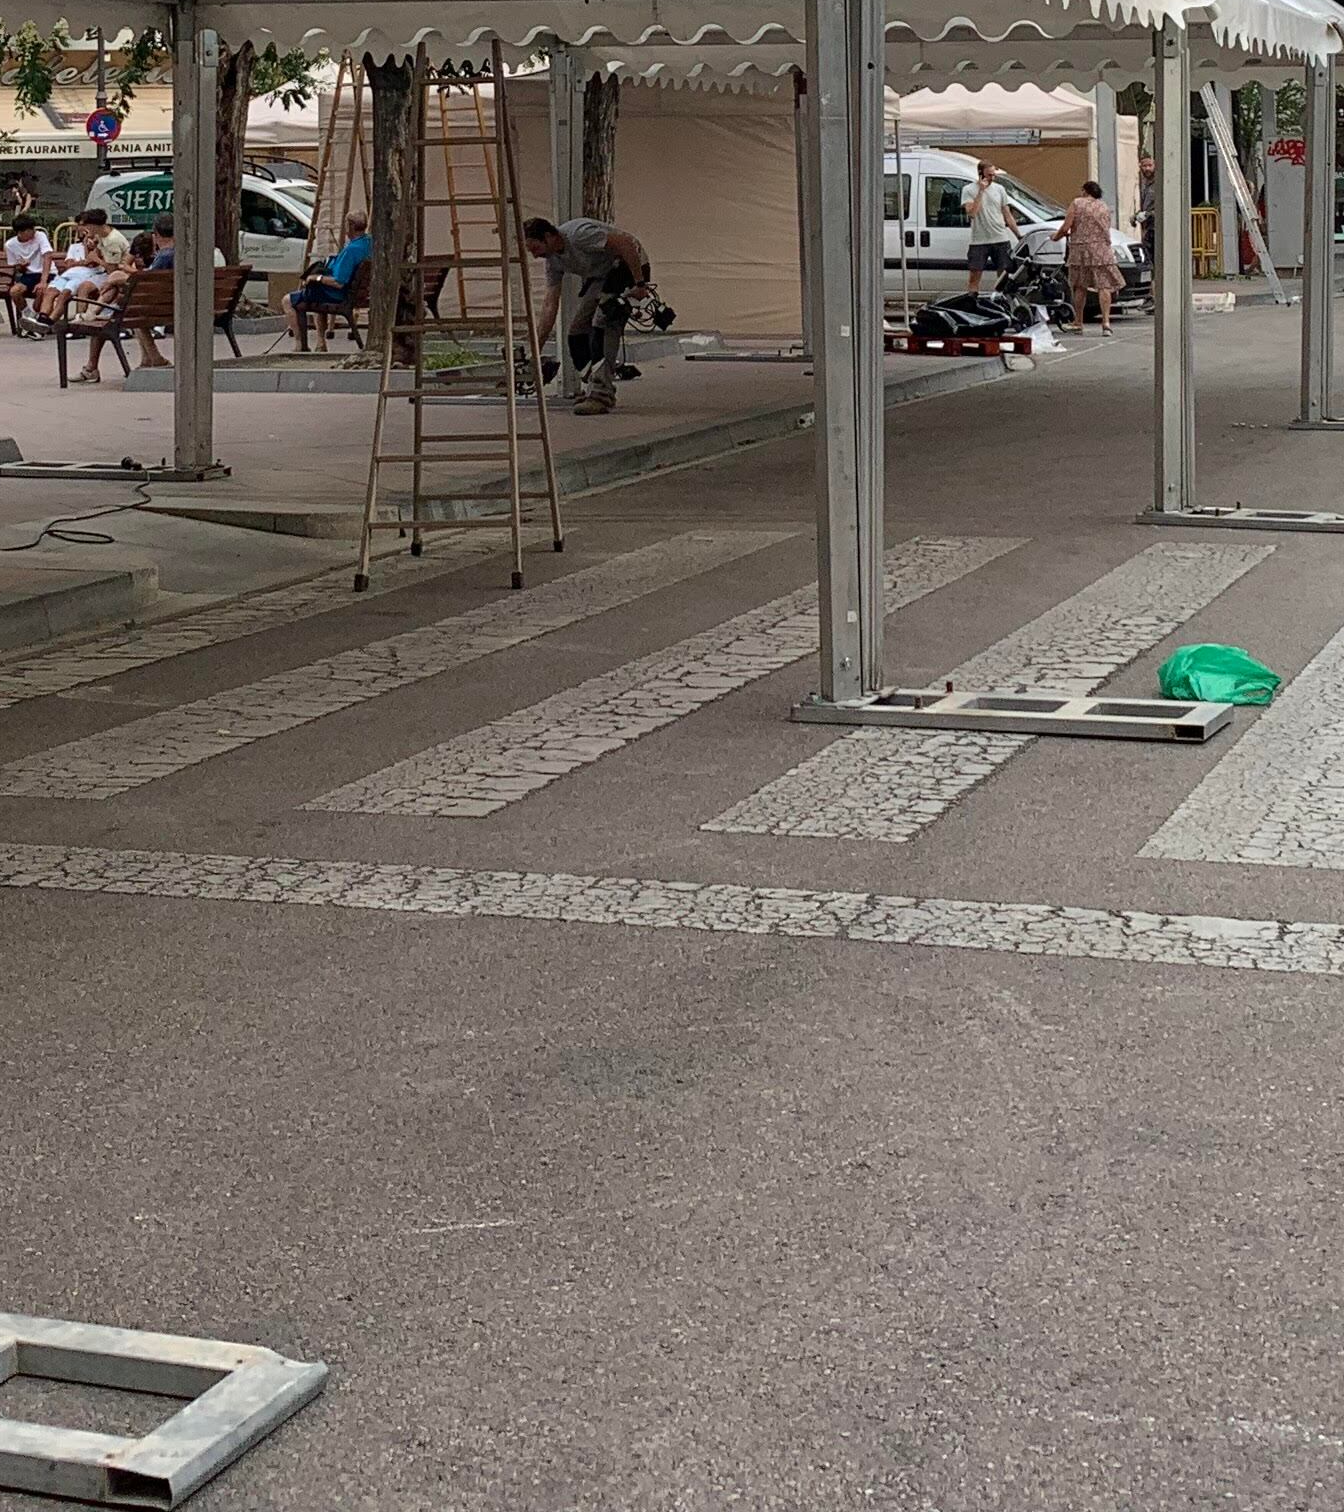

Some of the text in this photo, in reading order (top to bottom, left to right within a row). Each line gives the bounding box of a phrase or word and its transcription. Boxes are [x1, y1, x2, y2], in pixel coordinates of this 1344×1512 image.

[0, 143, 172, 155] RESTAURANTE RANJA ANIT
